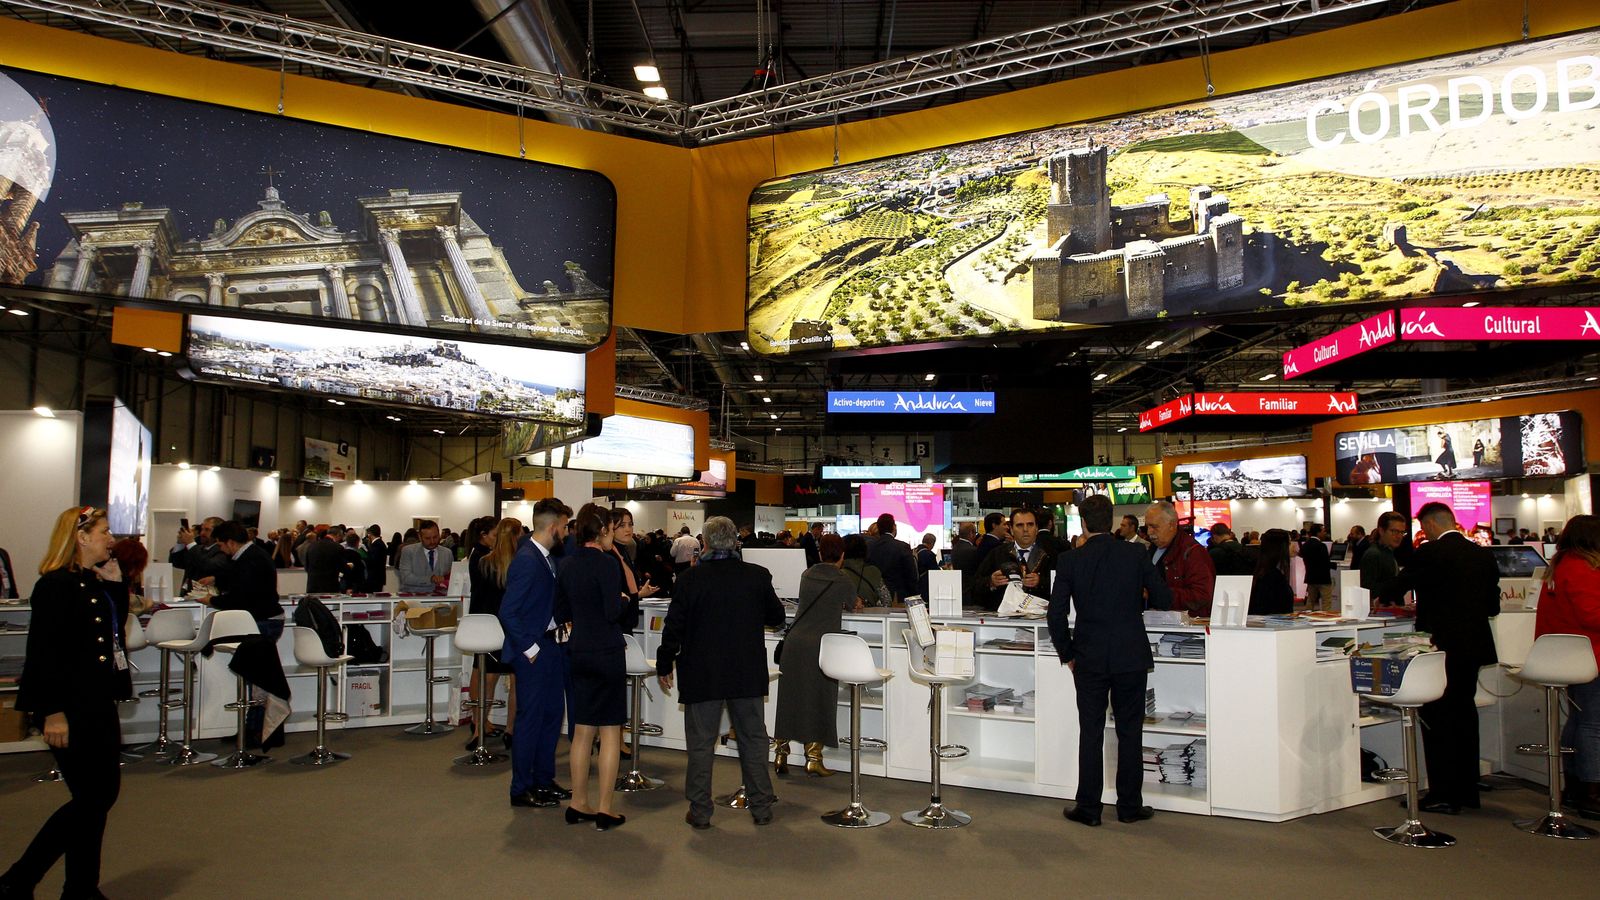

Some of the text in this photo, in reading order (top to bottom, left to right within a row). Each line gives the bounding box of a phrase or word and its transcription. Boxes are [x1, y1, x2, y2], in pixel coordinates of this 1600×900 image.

[1484, 315, 1541, 334] Cultural
[801, 335, 823, 344] Castillo
[1313, 339, 1339, 363] Cultural
[833, 393, 993, 412] Activo-deportivo Andalucía Nieve
[1259, 397, 1298, 411] Familiar
[339, 442, 348, 455] C
[1338, 433, 1396, 452] SEVILLA
[916, 443, 926, 456] B
[1073, 466, 1117, 479] Andalucía
[351, 682, 373, 690] FRAGIL
